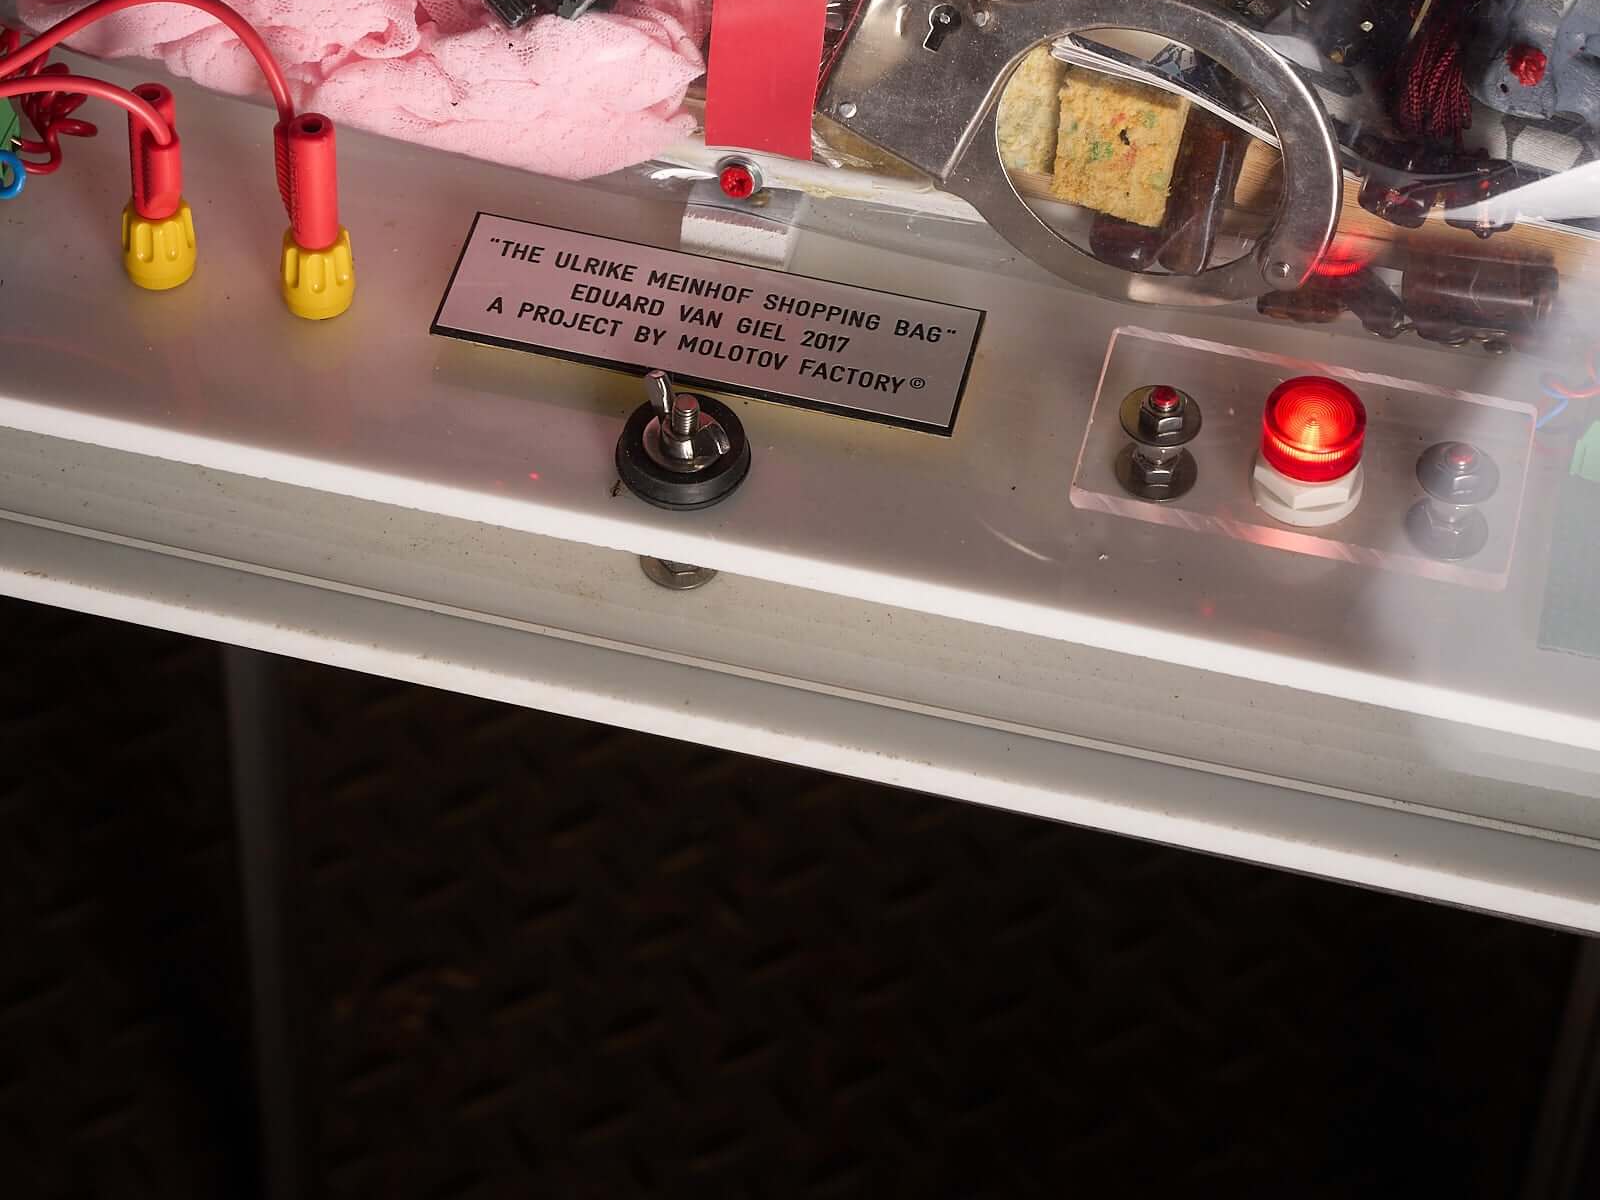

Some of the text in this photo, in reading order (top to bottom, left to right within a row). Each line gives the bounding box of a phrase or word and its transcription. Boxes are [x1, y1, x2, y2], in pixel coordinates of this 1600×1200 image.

[489, 237, 957, 343] "THE ULRIKE MEINHOF SHOPPING BAG"
[570, 283, 851, 353] EDUARD VAN GIEL 2017
[486, 296, 503, 315] A
[516, 301, 624, 337] PROJECT
[633, 325, 667, 346] BY
[677, 334, 789, 371] MOLOTOV
